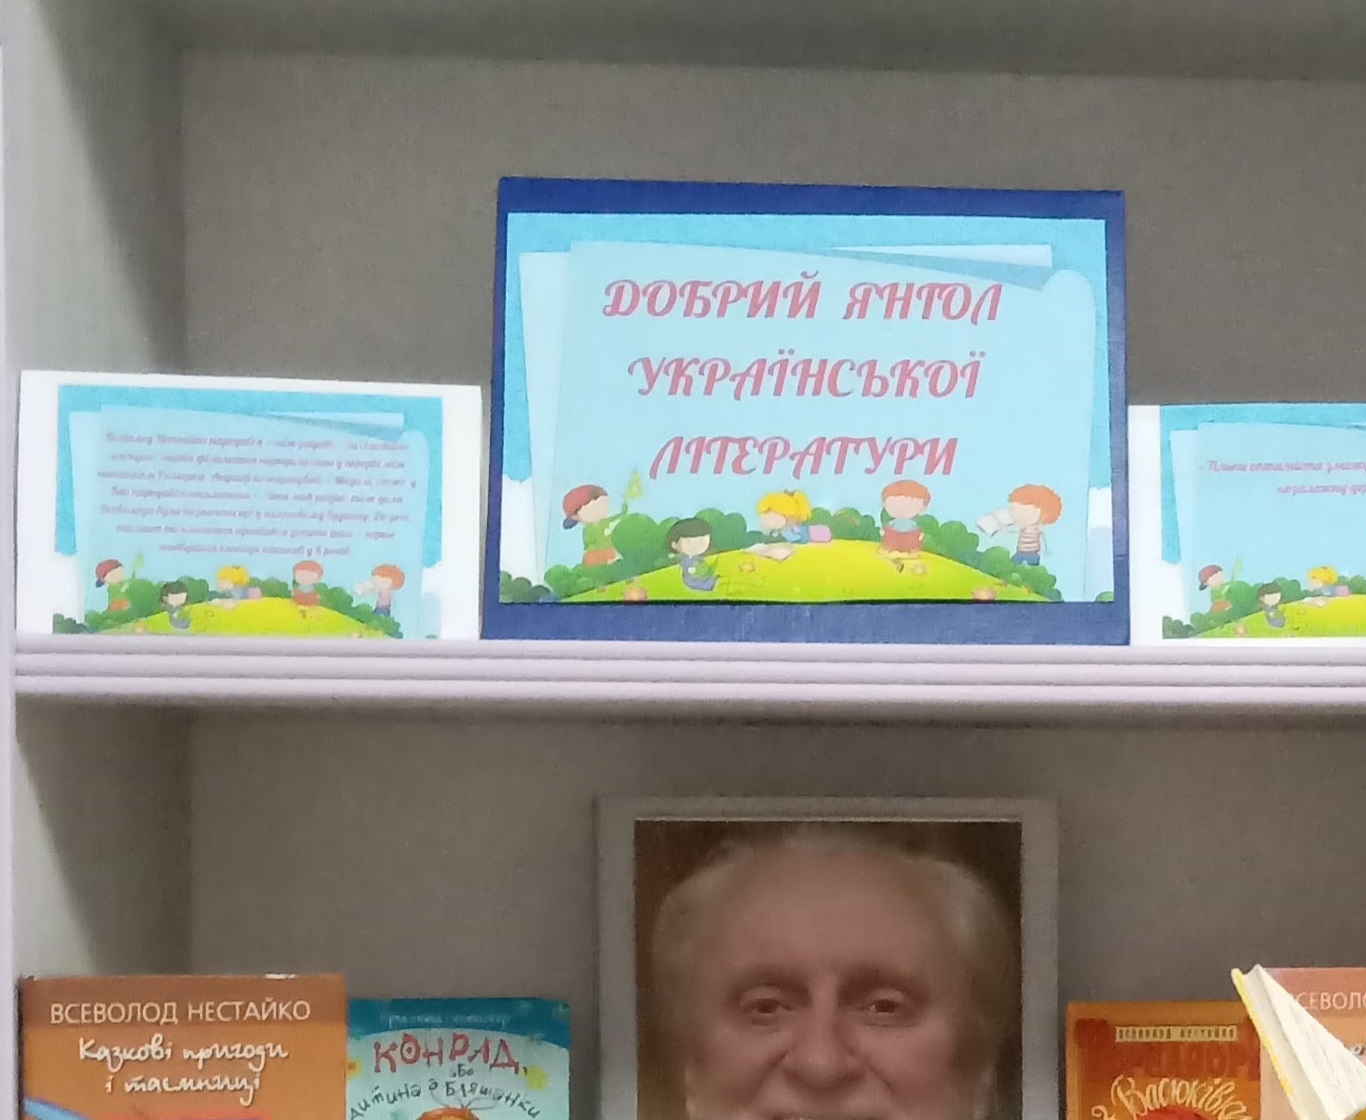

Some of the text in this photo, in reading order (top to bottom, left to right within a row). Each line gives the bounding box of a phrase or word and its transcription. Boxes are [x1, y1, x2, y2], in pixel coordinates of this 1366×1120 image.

[602, 269, 822, 320] ДОБРИЙ
[627, 347, 987, 401] УКРАЇНСЬКОЇ
[648, 434, 958, 480] ЛІТЕРАТУРИ
[49, 996, 312, 1026] ВСЕВОЛОД НЕСТАЙКО
[78, 1032, 289, 1073] Казкові пригоди
[104, 1071, 261, 1107] і таємниці
